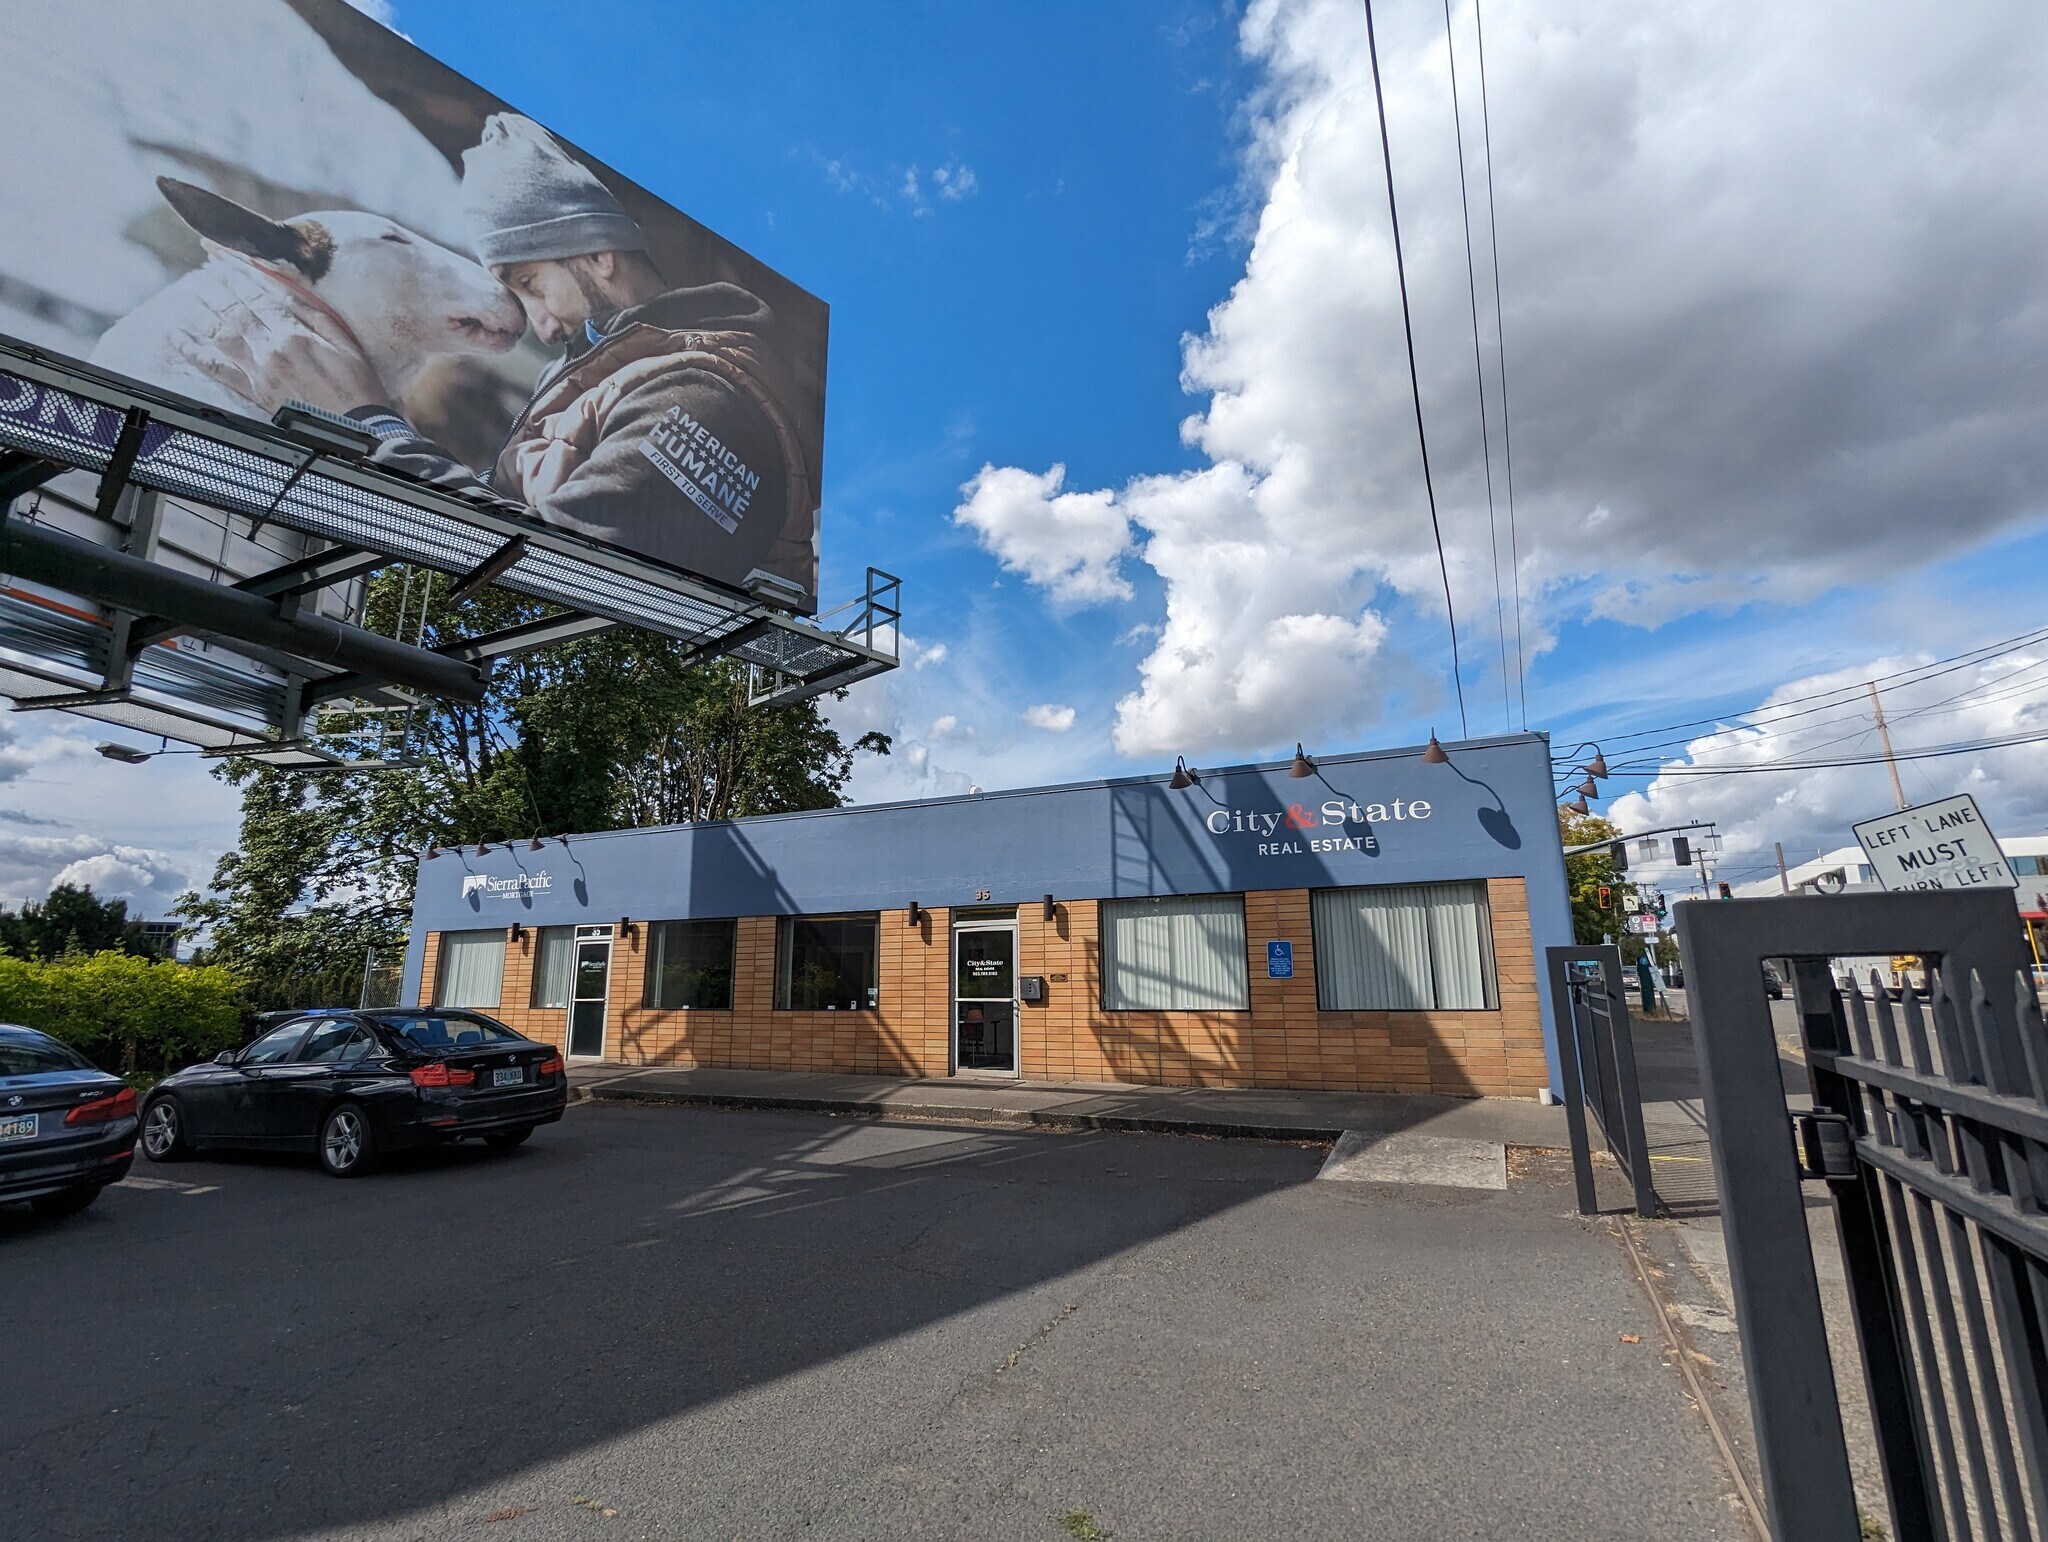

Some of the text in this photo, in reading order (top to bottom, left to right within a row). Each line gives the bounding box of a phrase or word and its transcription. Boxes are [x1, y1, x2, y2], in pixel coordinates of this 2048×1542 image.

[666, 405, 760, 490] AMERICAN
[649, 422, 750, 519] HUMANE
[650, 451, 728, 524] FIRST TO SERVE
[1258, 836, 1376, 856] REAL ESTATE
[1865, 808, 1976, 849] LEFT LANE
[1897, 839, 1967, 872] MUST
[1955, 862, 2003, 886] LEFT
[0, 1120, 34, 1136] 4189
